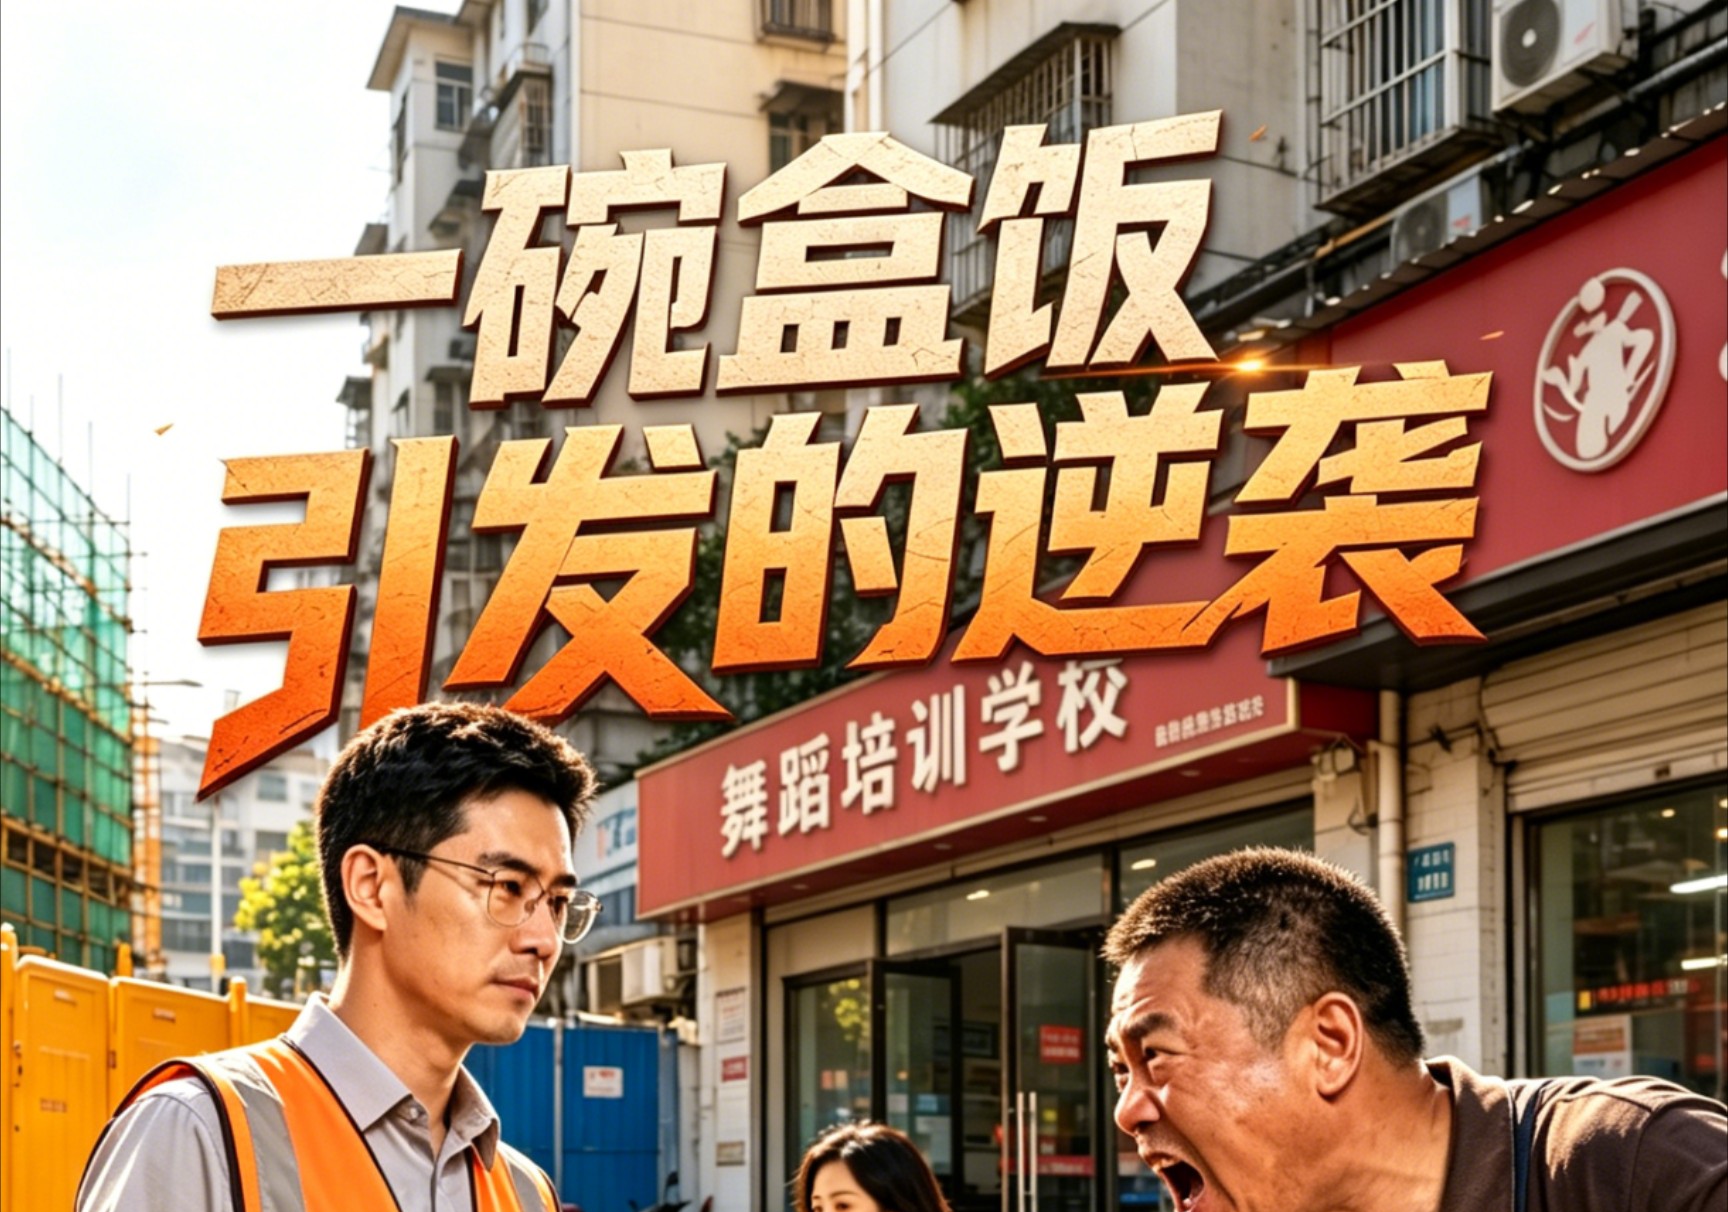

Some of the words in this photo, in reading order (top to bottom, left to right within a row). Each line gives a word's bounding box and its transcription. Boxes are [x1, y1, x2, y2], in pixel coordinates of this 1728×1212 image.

[719, 657, 1129, 858] 舞蹈培训学校
